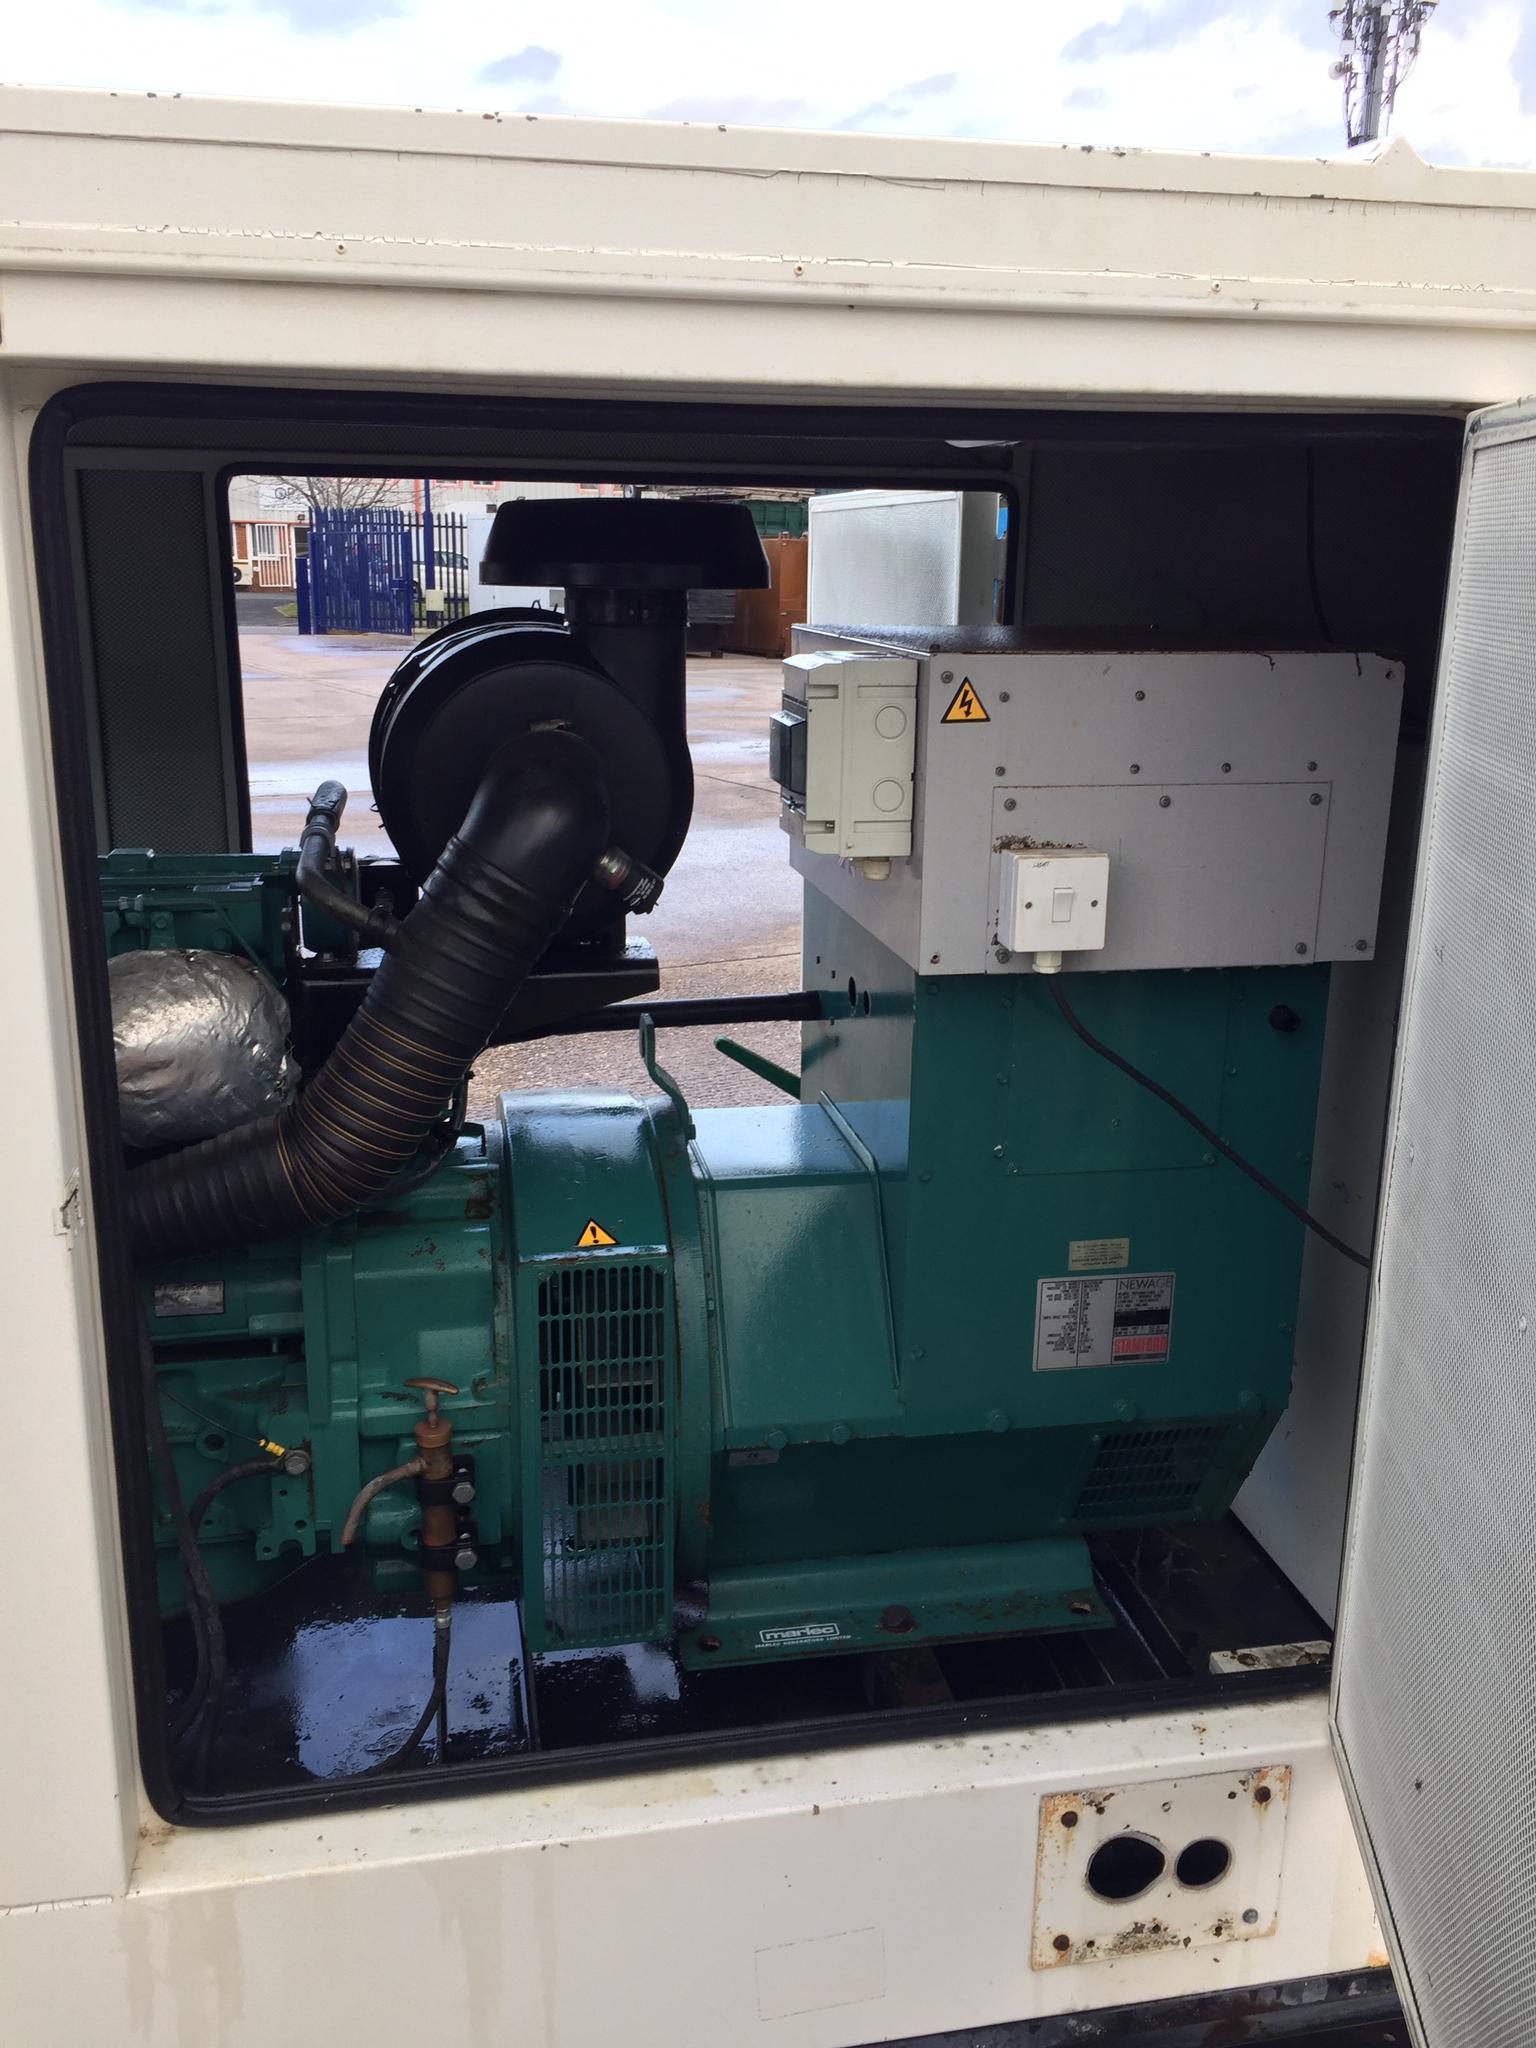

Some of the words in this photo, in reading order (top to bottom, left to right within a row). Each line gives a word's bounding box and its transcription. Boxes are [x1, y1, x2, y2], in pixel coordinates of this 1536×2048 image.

[1119, 1277, 1173, 1290] NEWAGE
[1114, 1337, 1167, 1354] STAMFORD
[765, 1627, 834, 1640] marlec
